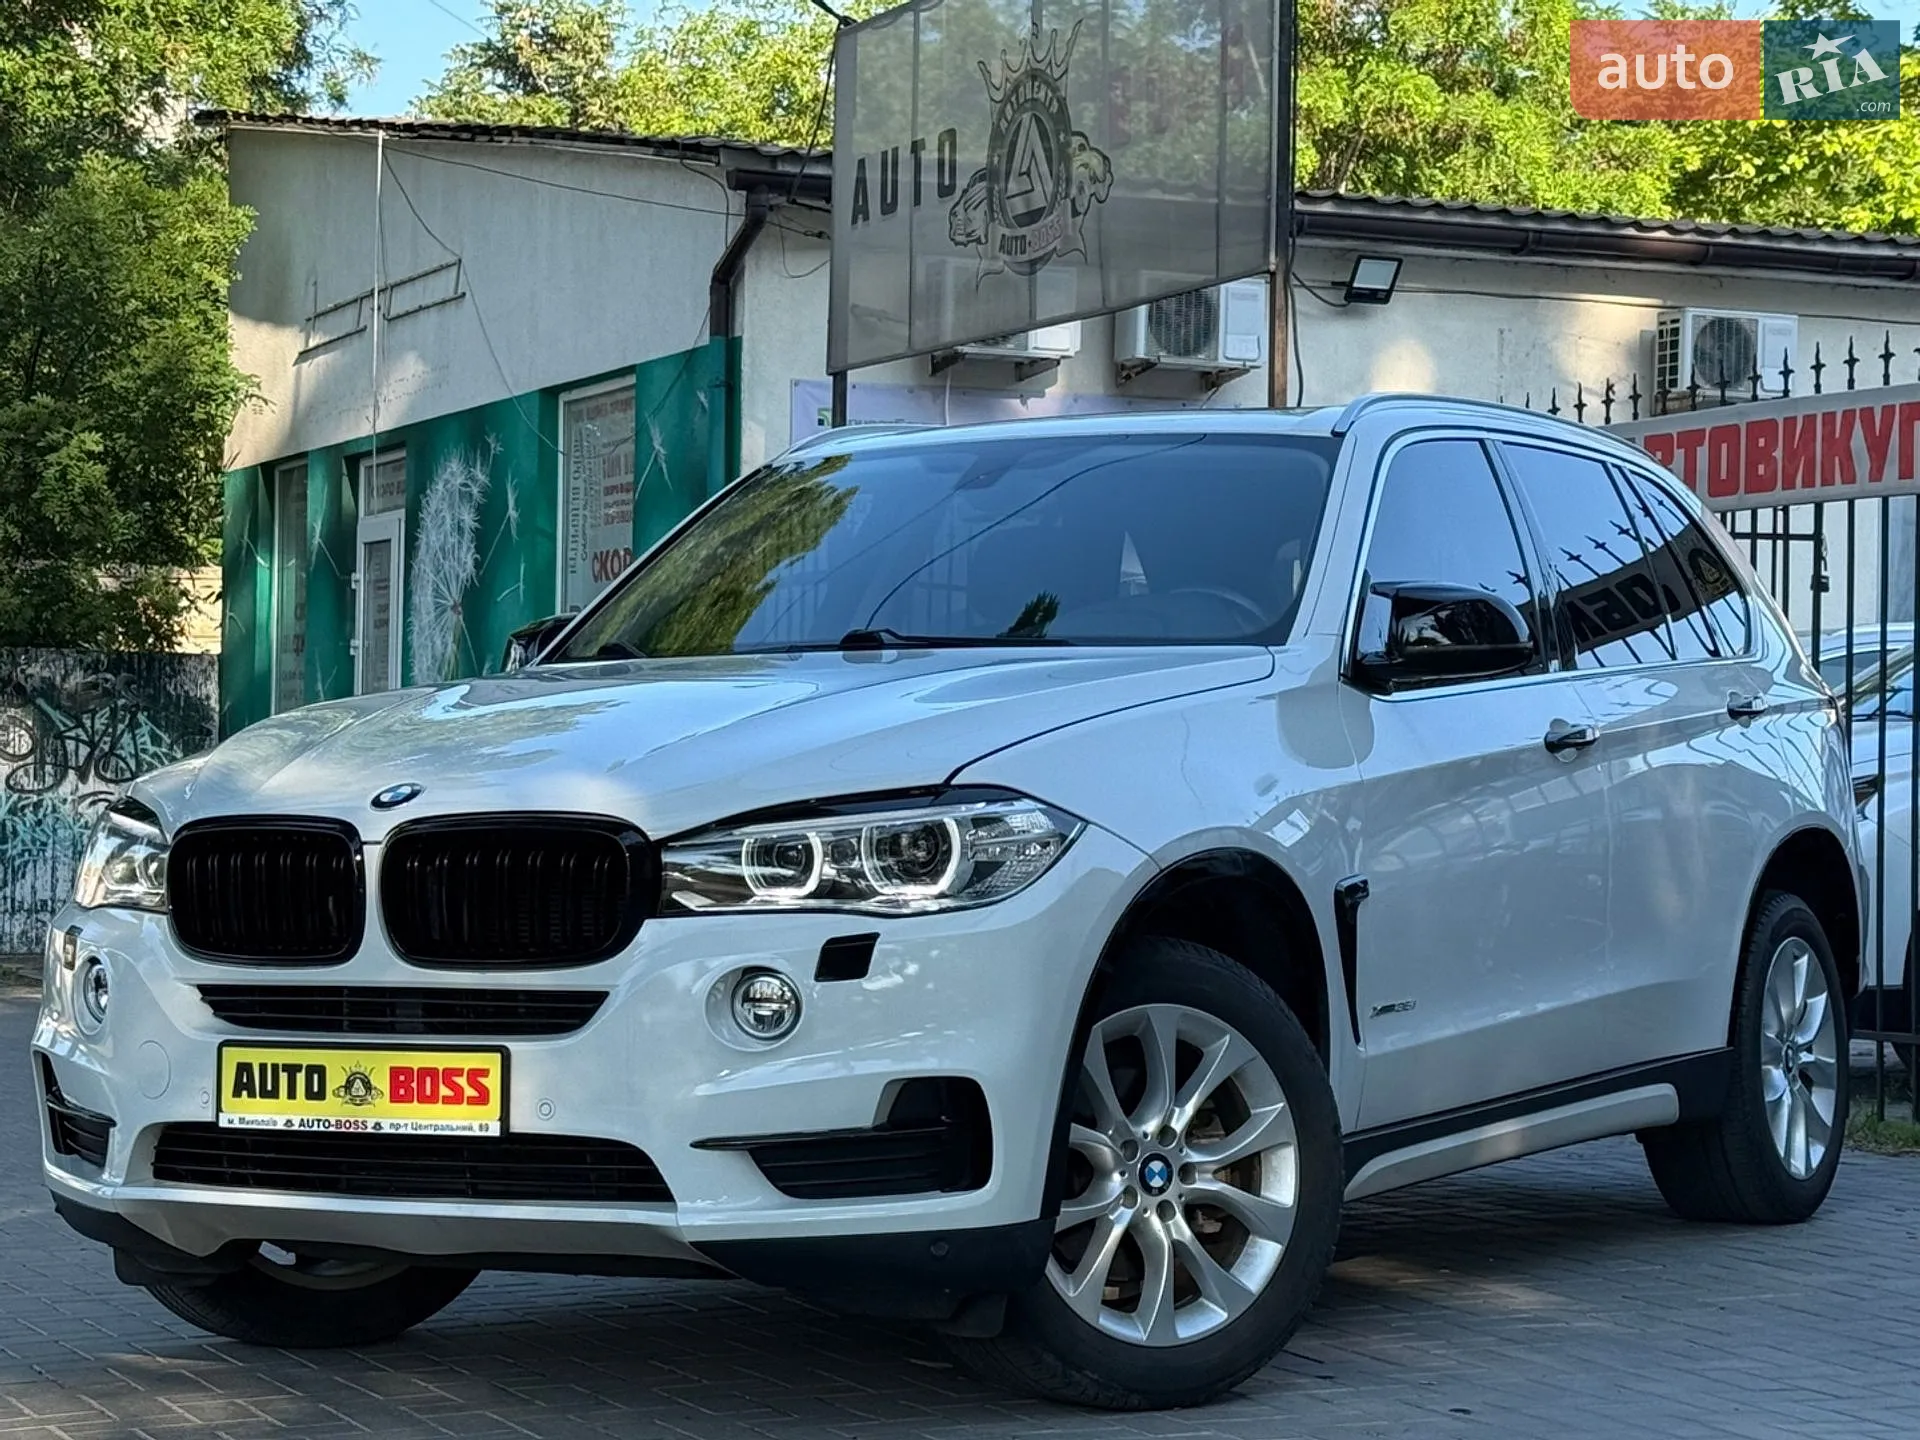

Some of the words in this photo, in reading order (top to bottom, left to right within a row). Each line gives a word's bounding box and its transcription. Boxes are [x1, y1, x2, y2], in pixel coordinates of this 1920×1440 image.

[850, 127, 958, 226] AUTO
[232, 1061, 327, 1101] AUTO
[388, 1066, 490, 1106] BOSS
[298, 1118, 368, 1131] AUTO-BOSS
